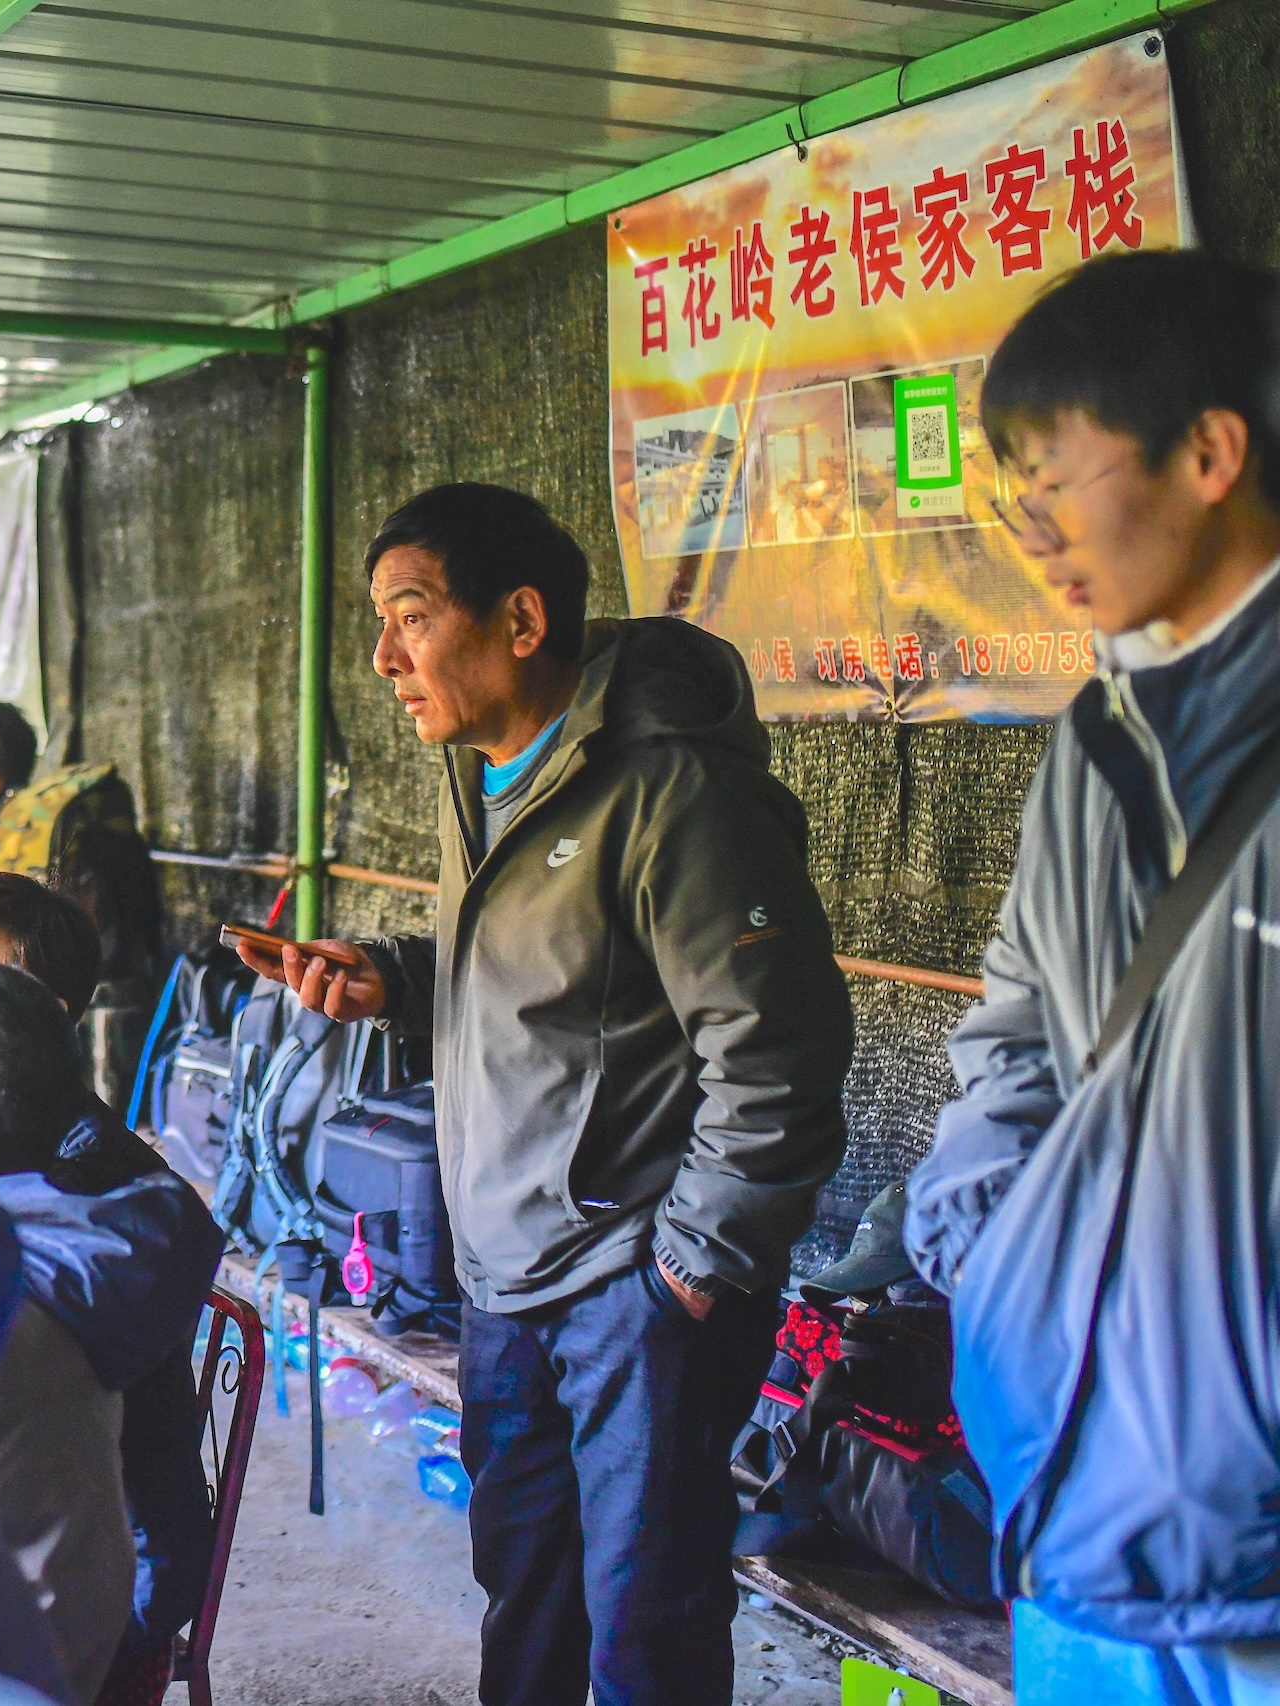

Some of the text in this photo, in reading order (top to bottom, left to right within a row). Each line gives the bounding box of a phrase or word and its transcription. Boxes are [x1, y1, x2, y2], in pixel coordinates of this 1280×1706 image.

[633, 119, 1144, 359] 百花岭老侯家客栈
[922, 494, 952, 507] 微信支付
[751, 637, 797, 683] 小侯
